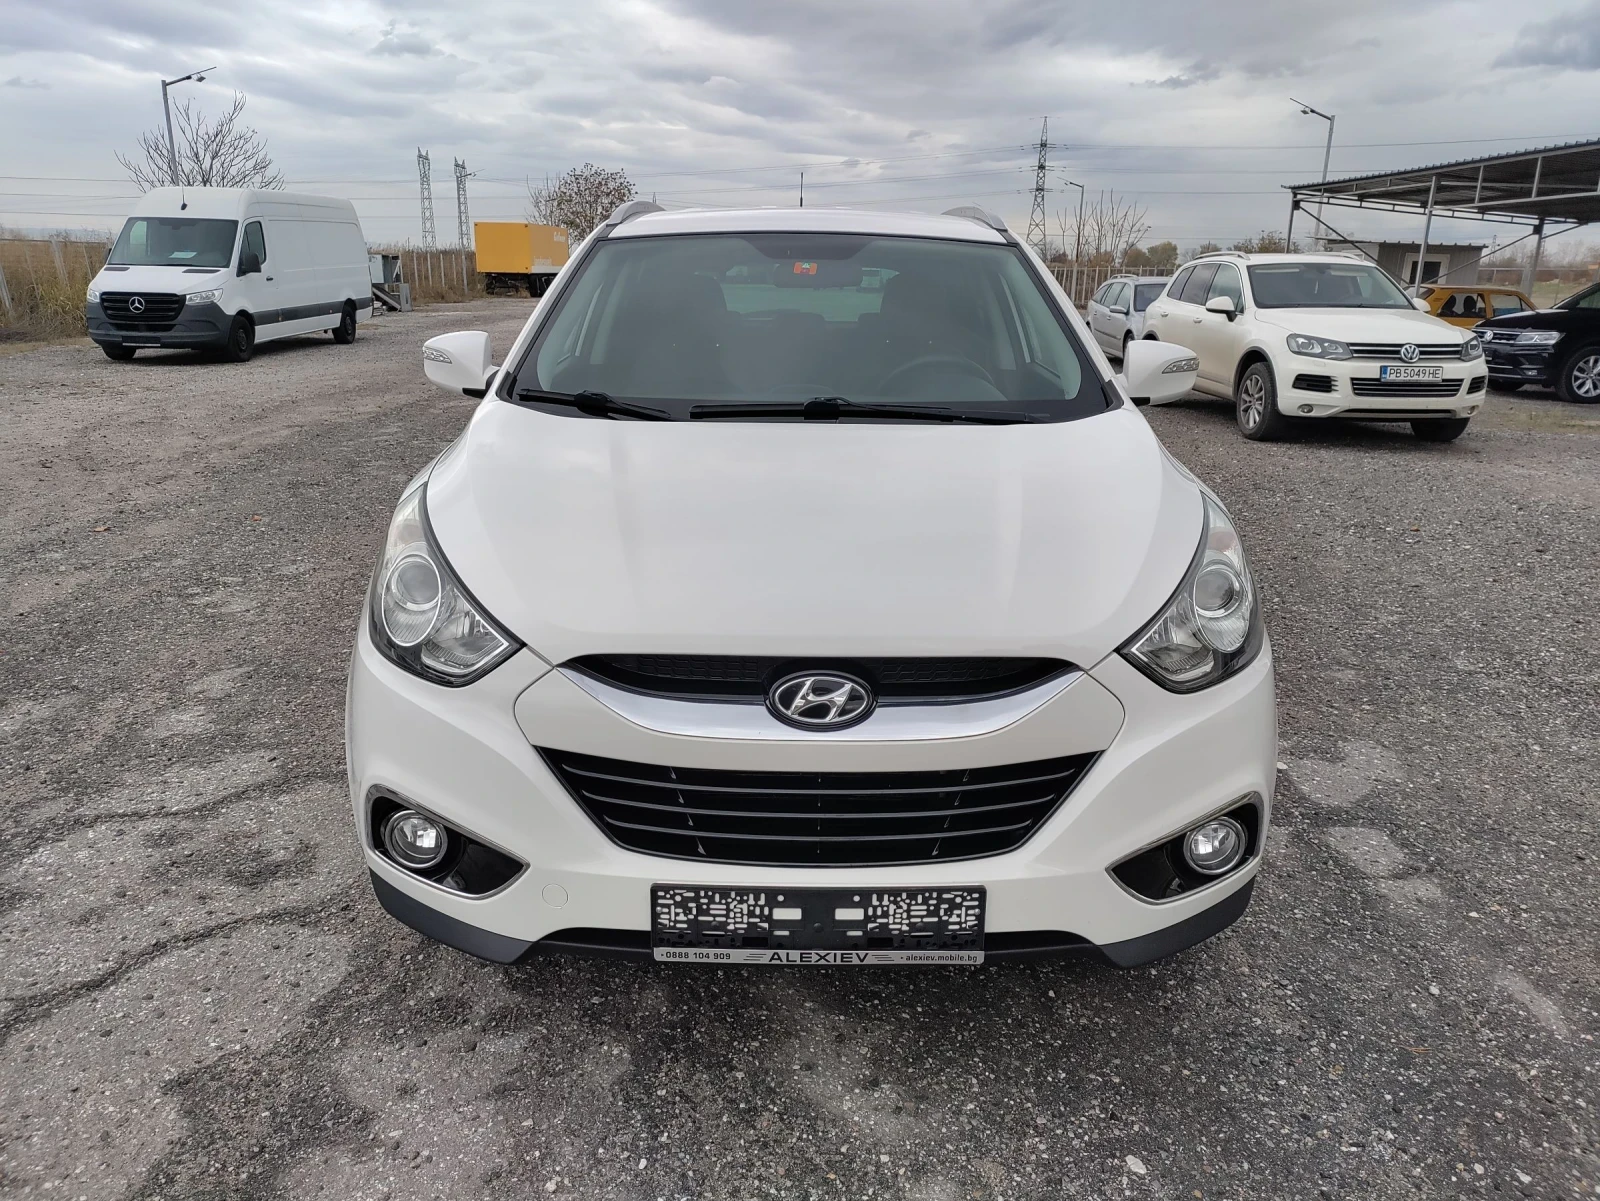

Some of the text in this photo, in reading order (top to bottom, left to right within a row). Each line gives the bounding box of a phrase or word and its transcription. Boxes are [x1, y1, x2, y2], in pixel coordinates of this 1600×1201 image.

[1388, 368, 1440, 378] PB 5049 HE
[665, 951, 978, 963] 0888 104 909 ALEXIEV alexiev.mobile.bg
